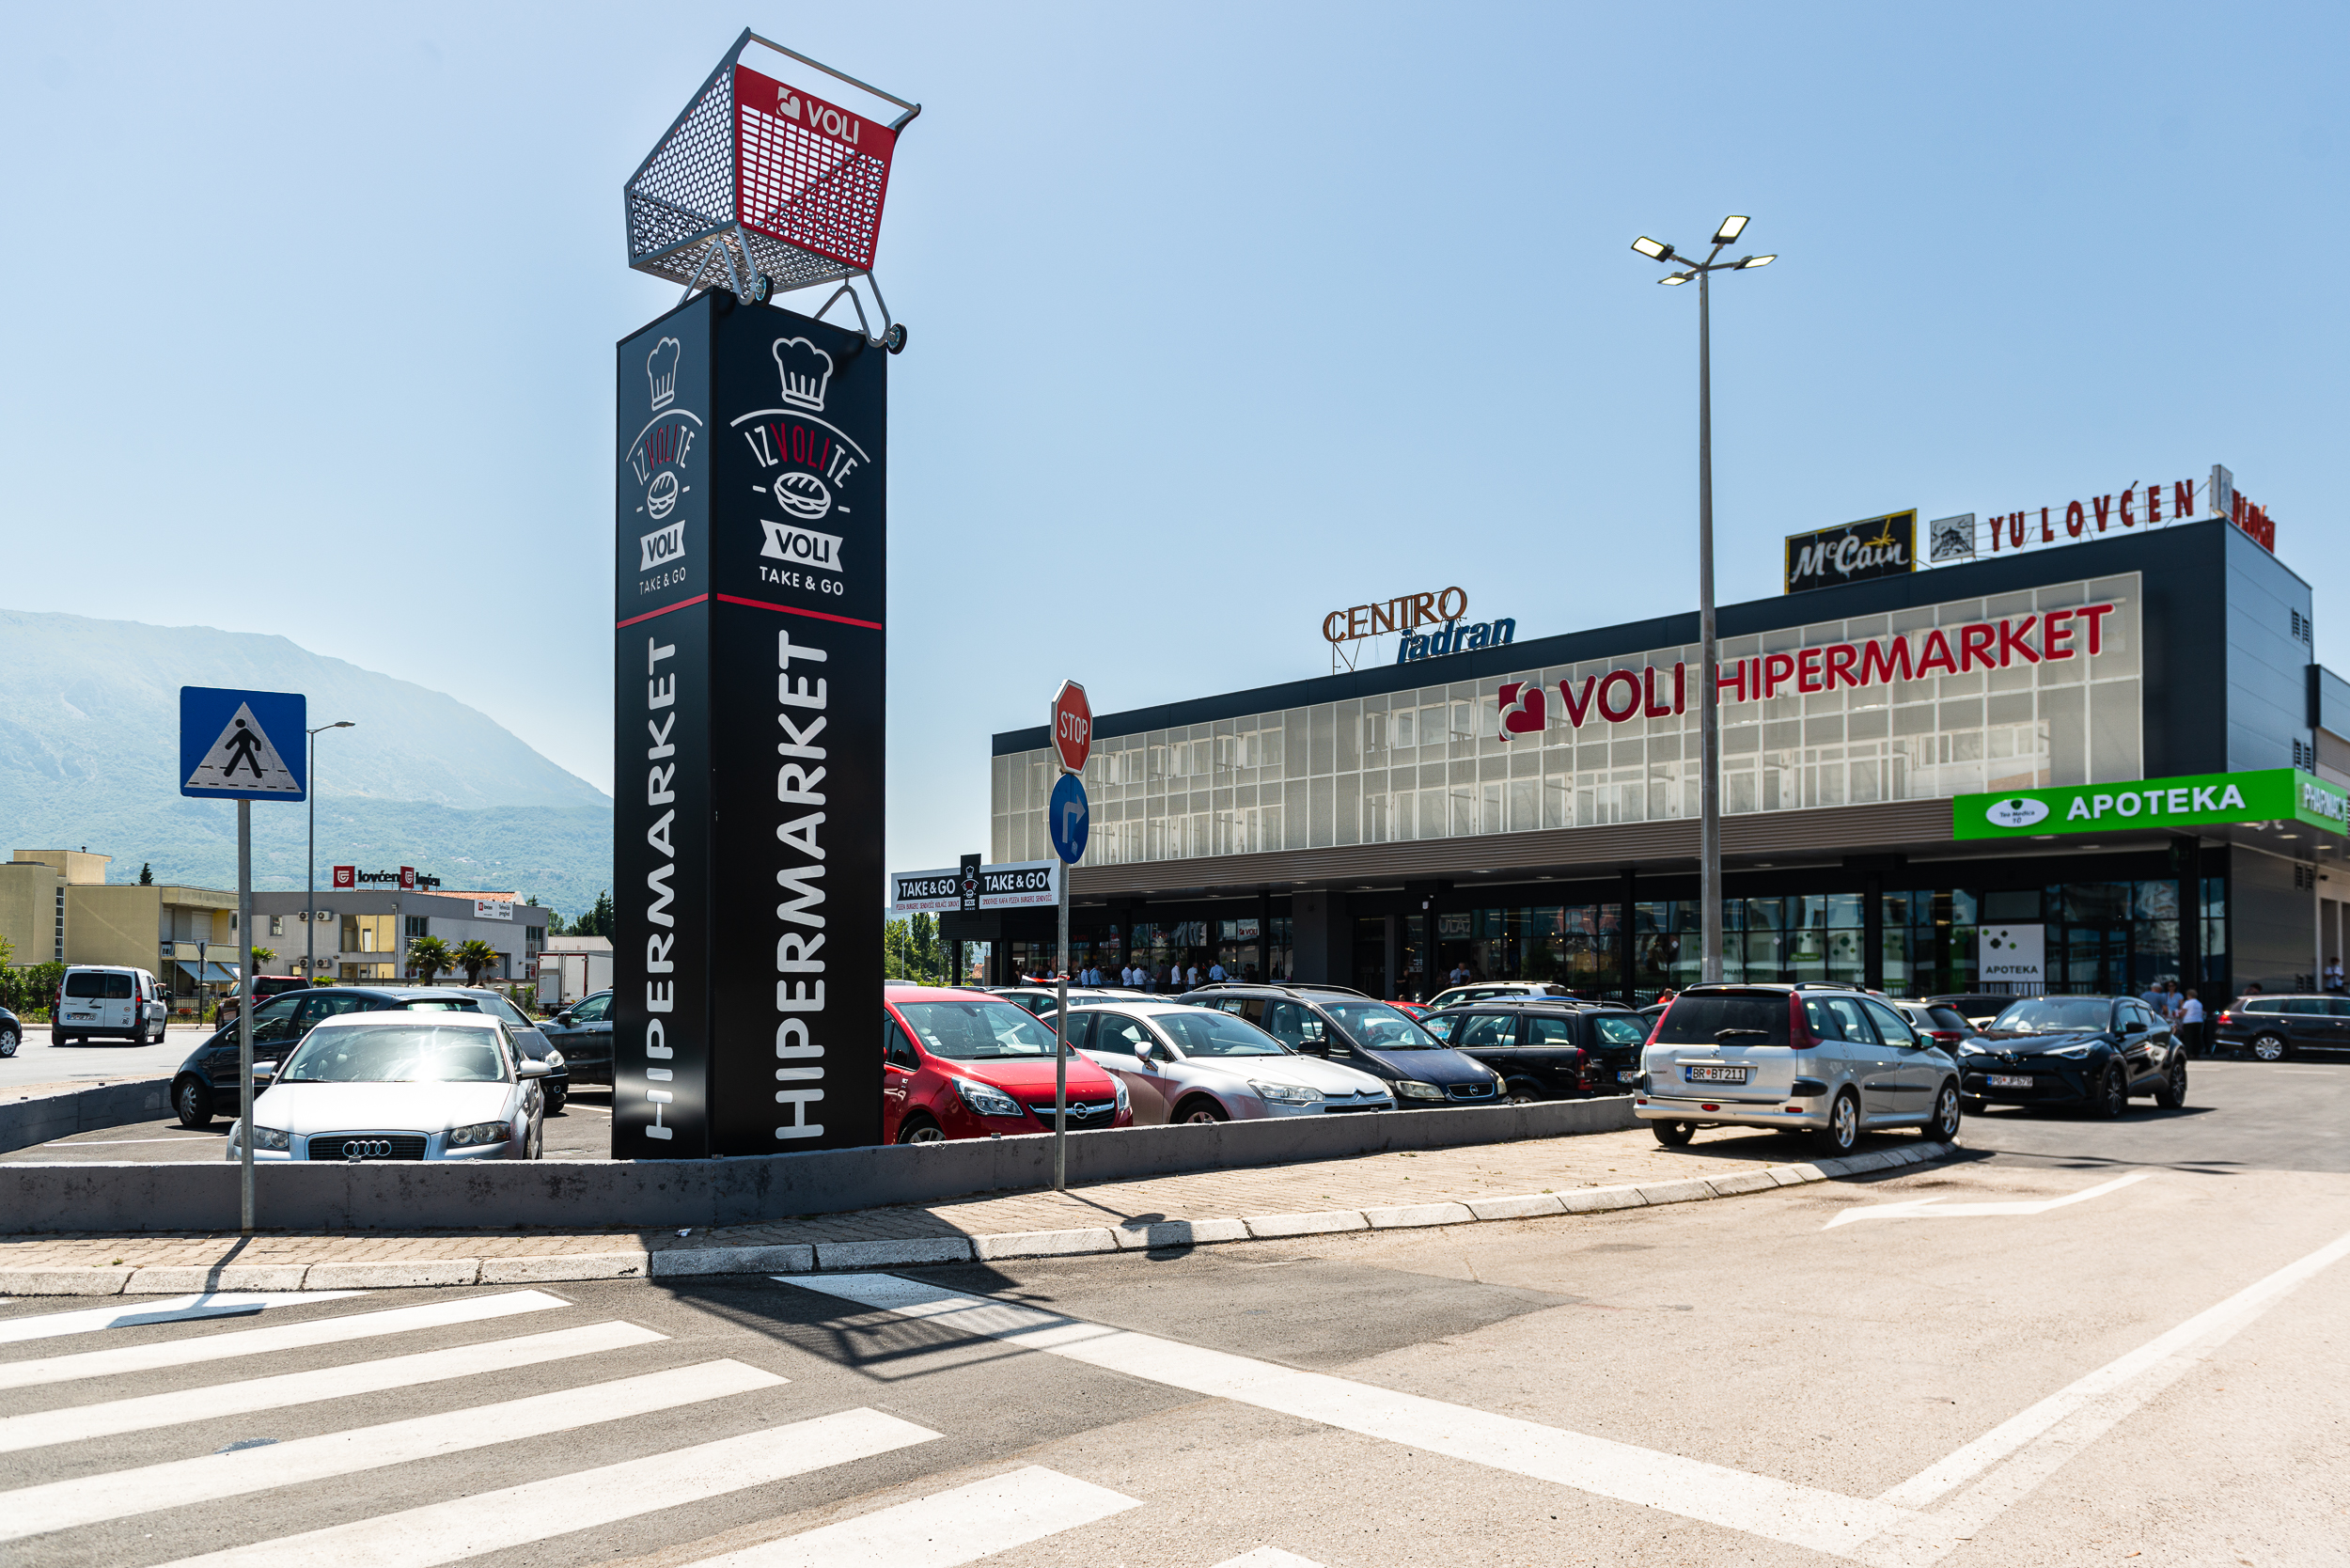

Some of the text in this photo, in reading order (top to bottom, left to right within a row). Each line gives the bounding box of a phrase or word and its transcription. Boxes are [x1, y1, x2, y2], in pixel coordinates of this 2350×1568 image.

[807, 100, 859, 145] VOLI
[633, 423, 695, 486] IZVOLITE
[744, 422, 858, 488] IZVOLITE
[647, 528, 678, 562] VOLI
[775, 528, 829, 563] VOLI
[1789, 535, 1909, 584] McCain
[639, 567, 686, 595] TAKE & GO
[760, 566, 843, 596] TAKE & GO
[1323, 586, 1467, 643] CENTRO
[1397, 618, 1516, 664] jadran
[1559, 603, 2115, 729] VOLI HIPERMARKET
[1060, 711, 1089, 745] STOP
[2067, 783, 2247, 822] APOTEKA
[646, 636, 676, 1140] HIPERMARKET
[775, 629, 827, 1140] HIPERMARKET
[1985, 965, 2039, 974] APOTEKA
[1693, 1068, 1744, 1080] BR BT211
